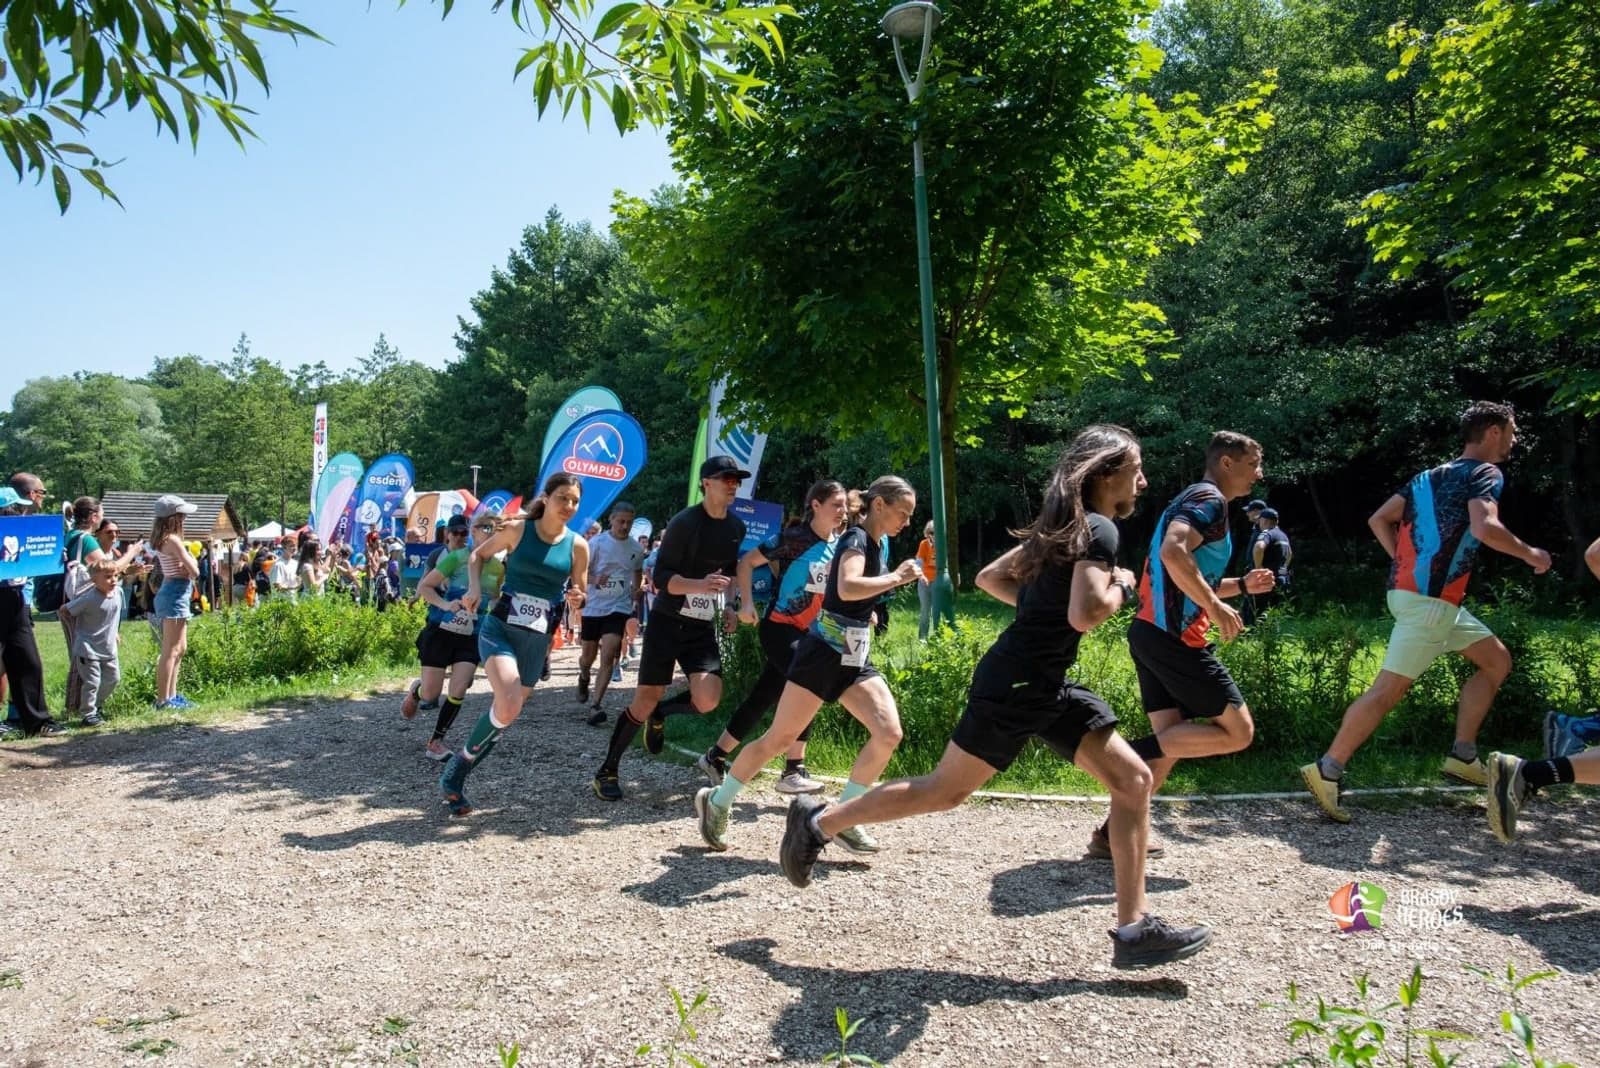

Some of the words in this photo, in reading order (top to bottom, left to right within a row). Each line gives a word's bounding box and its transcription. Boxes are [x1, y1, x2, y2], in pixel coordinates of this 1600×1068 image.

[568, 459, 621, 478] OLYMPUS
[369, 474, 408, 487] esdent
[519, 603, 542, 618] 693
[691, 597, 710, 610] 690
